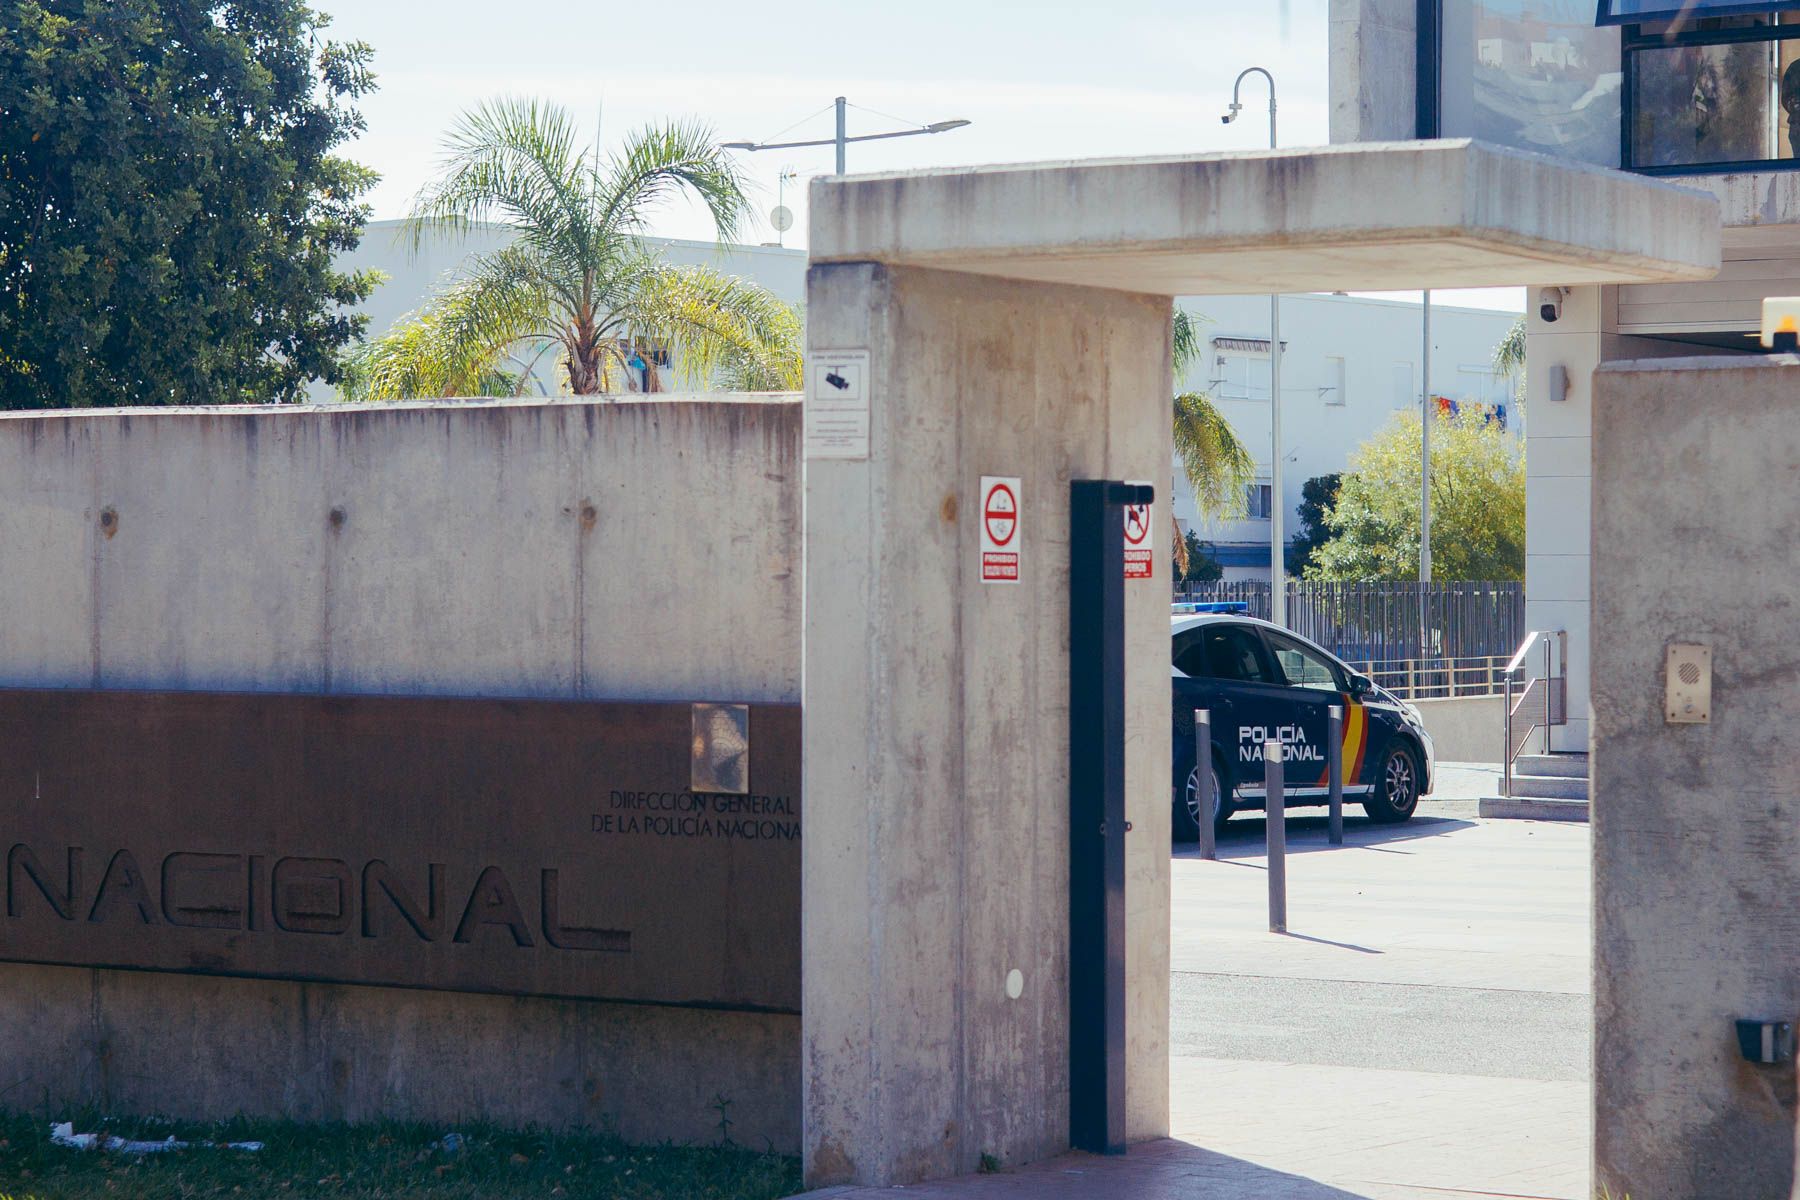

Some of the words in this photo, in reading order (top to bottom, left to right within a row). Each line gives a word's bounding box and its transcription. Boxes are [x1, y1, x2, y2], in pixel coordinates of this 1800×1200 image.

[1238, 723, 1306, 743] POLICÍA
[1239, 744, 1325, 762] NAONAL
[610, 787, 706, 812] DIRECCIÓN
[713, 794, 794, 815] GENERAL
[591, 814, 612, 833] DE
[618, 815, 640, 834] LA
[644, 813, 712, 837] POLICÍA
[717, 819, 803, 840] NACIONA
[7, 843, 632, 952] NACIONAL
